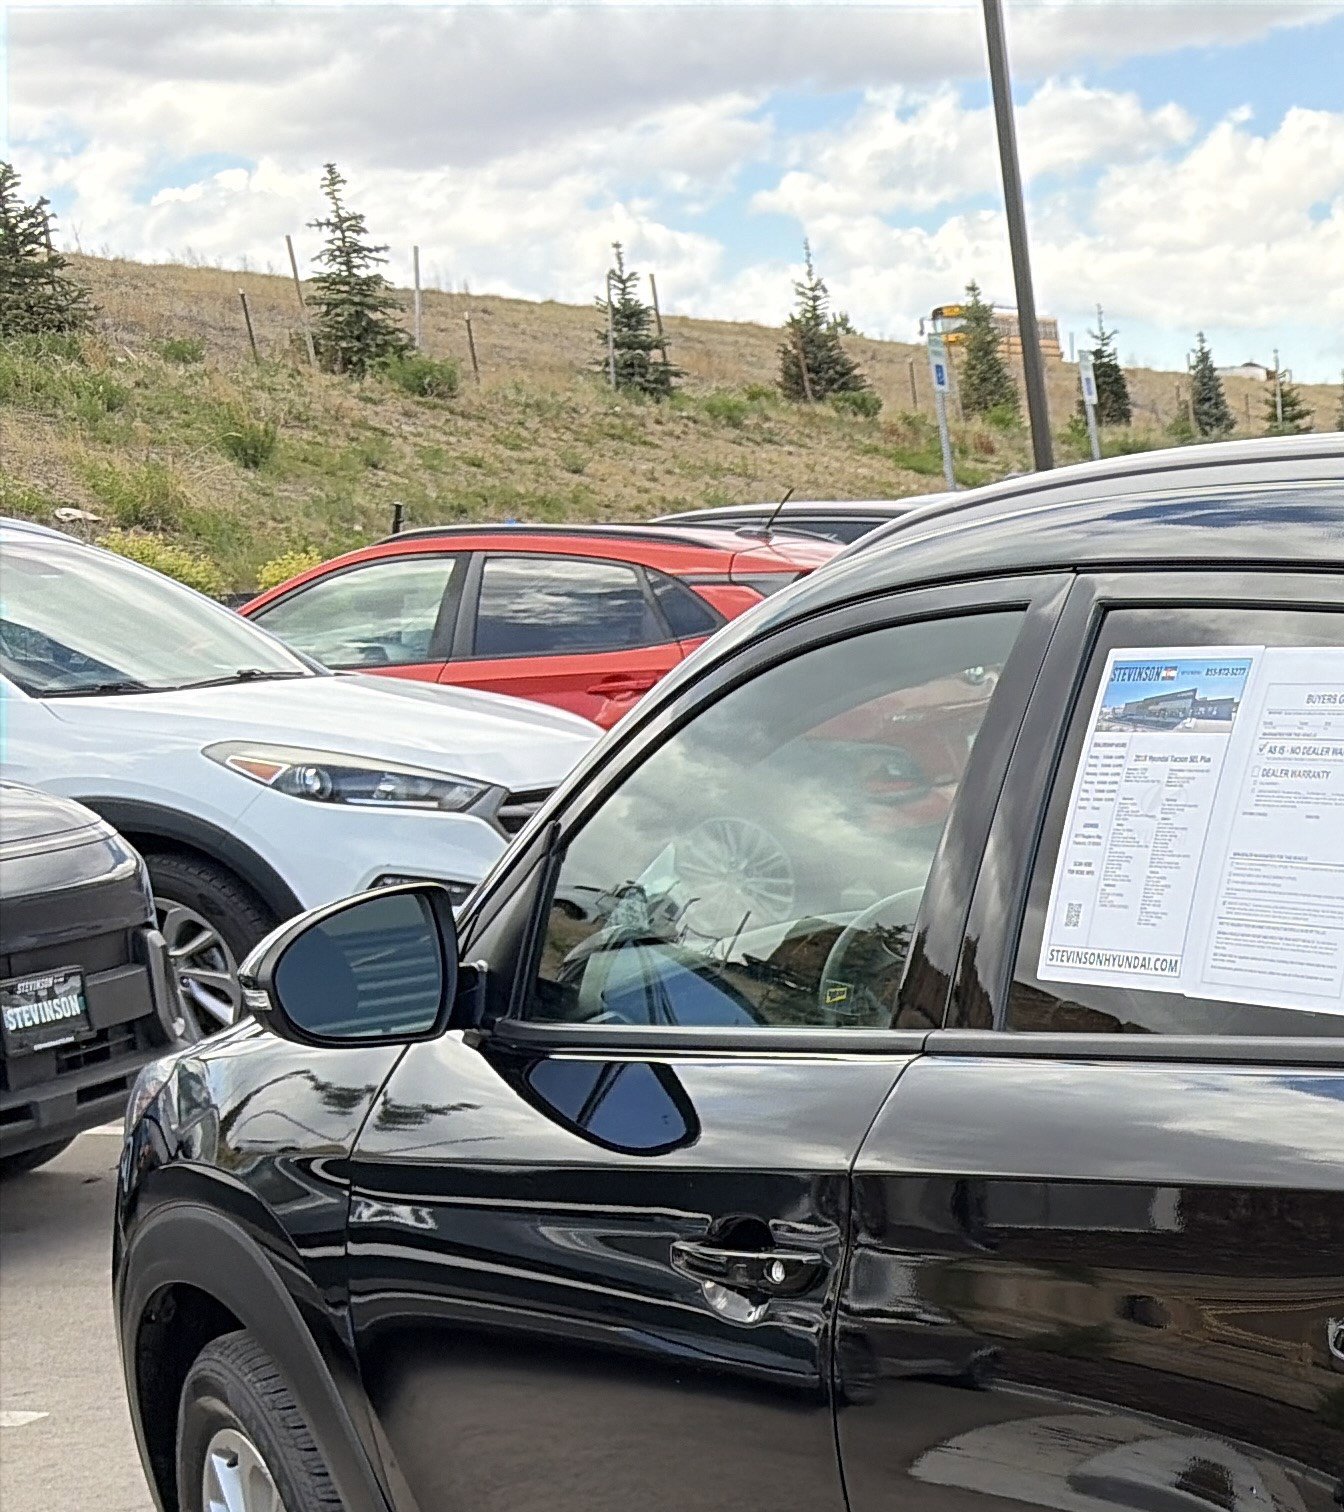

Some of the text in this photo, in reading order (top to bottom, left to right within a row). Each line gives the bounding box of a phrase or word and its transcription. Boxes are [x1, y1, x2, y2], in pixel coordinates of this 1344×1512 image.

[1111, 666, 1163, 682] STEVINSON
[1305, 694, 1338, 705] BUYERS
[1290, 746, 1302, 756] NO
[1302, 746, 1331, 757] DEALER
[1261, 768, 1332, 780] DEALER WARRANTY
[1049, 948, 1179, 973] STEVINSONHYUNDAI.COM
[6, 993, 81, 1031] STEVINSON
